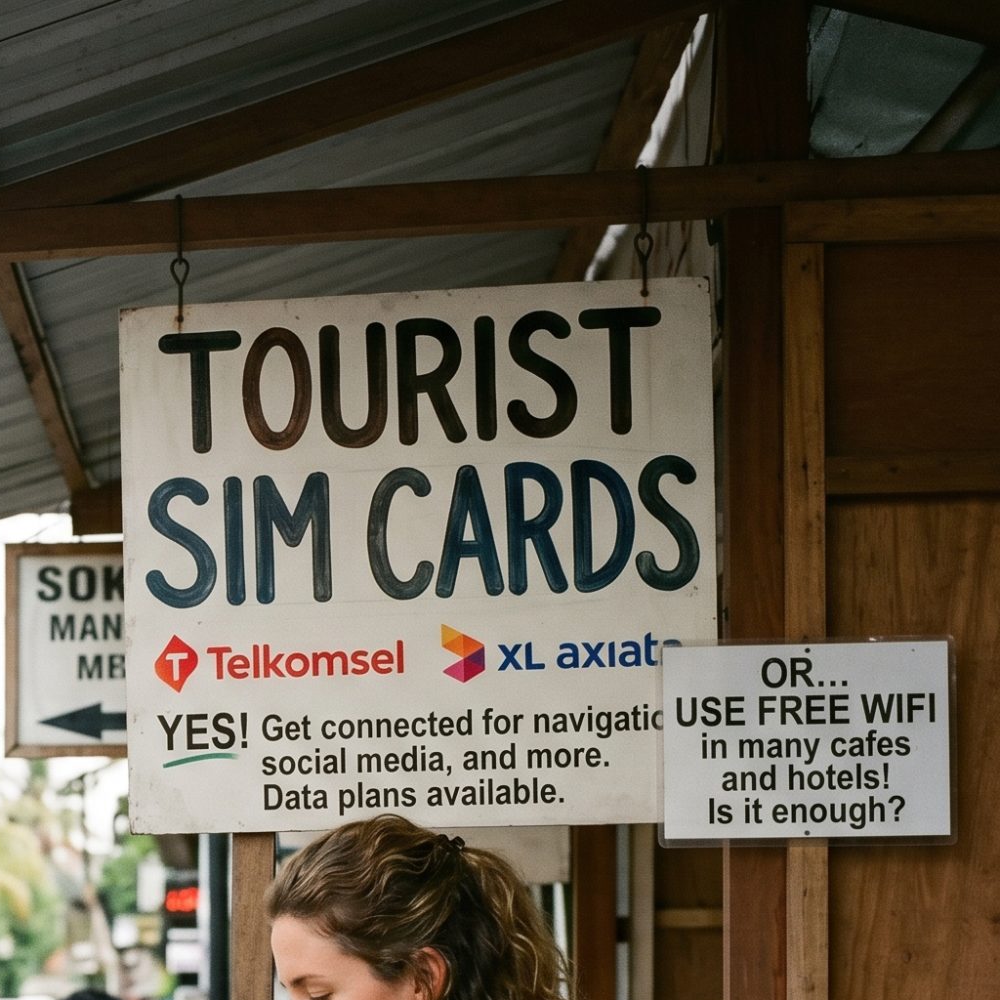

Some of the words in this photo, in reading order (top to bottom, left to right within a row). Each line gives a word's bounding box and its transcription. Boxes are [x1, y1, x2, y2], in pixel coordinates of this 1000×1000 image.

[158, 307, 662, 454] TOURIST
[145, 471, 333, 609] SIM
[366, 455, 701, 600] CARDS
[50, 614, 122, 641] MAN
[206, 639, 405, 680] Telkomsel
[497, 641, 546, 672] XL
[556, 631, 682, 669] axiat
[761, 657, 849, 688] OR...
[261, 713, 312, 742] Get
[321, 708, 473, 741] connected
[482, 707, 524, 735] for
[533, 703, 664, 739] navigatio
[676, 696, 746, 727] USE
[758, 693, 850, 726] FREE
[860, 692, 936, 724] WIFI
[157, 712, 248, 751] YES!
[701, 732, 728, 760] in
[738, 736, 821, 765] many
[830, 729, 912, 758] cafes
[261, 747, 346, 776] social
[356, 744, 452, 776] media,
[462, 742, 517, 771] and
[526, 745, 610, 769] more.
[721, 764, 776, 791] and
[788, 762, 890, 791] hotels!
[263, 783, 329, 811] Data
[338, 781, 417, 817] plans
[426, 777, 565, 807] available.
[708, 797, 733, 825] Is
[744, 797, 763, 825] it
[771, 795, 906, 830] enough?
